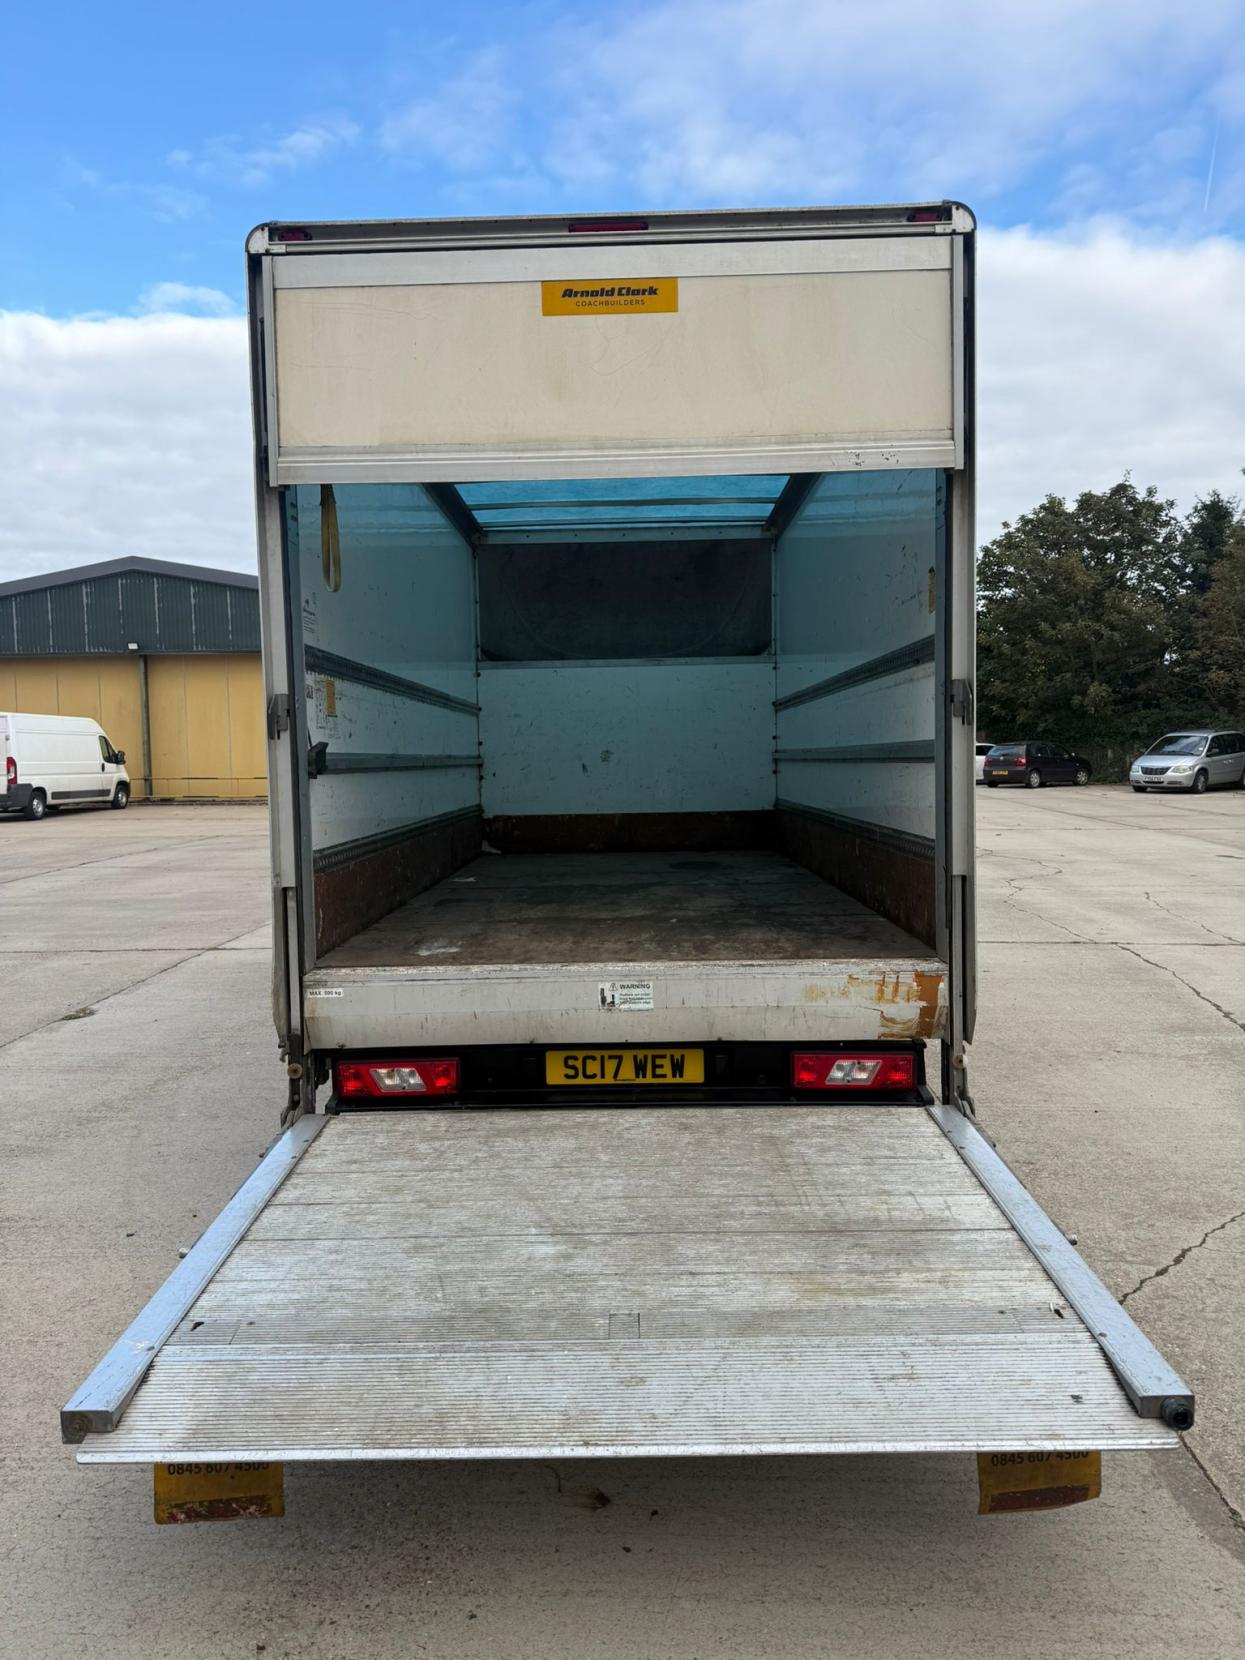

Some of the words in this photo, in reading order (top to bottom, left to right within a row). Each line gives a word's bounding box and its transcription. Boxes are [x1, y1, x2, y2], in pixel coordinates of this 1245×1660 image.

[562, 287, 615, 298] Arnold
[617, 286, 659, 296] Clark
[575, 299, 645, 307] COACHBUILDERS
[563, 1055, 624, 1080] SC17
[633, 1054, 686, 1079] WEW
[991, 1452, 1025, 1467] 0845
[1028, 1452, 1052, 1463] 607
[167, 1463, 203, 1475] 0845
[205, 1462, 231, 1474] 607
